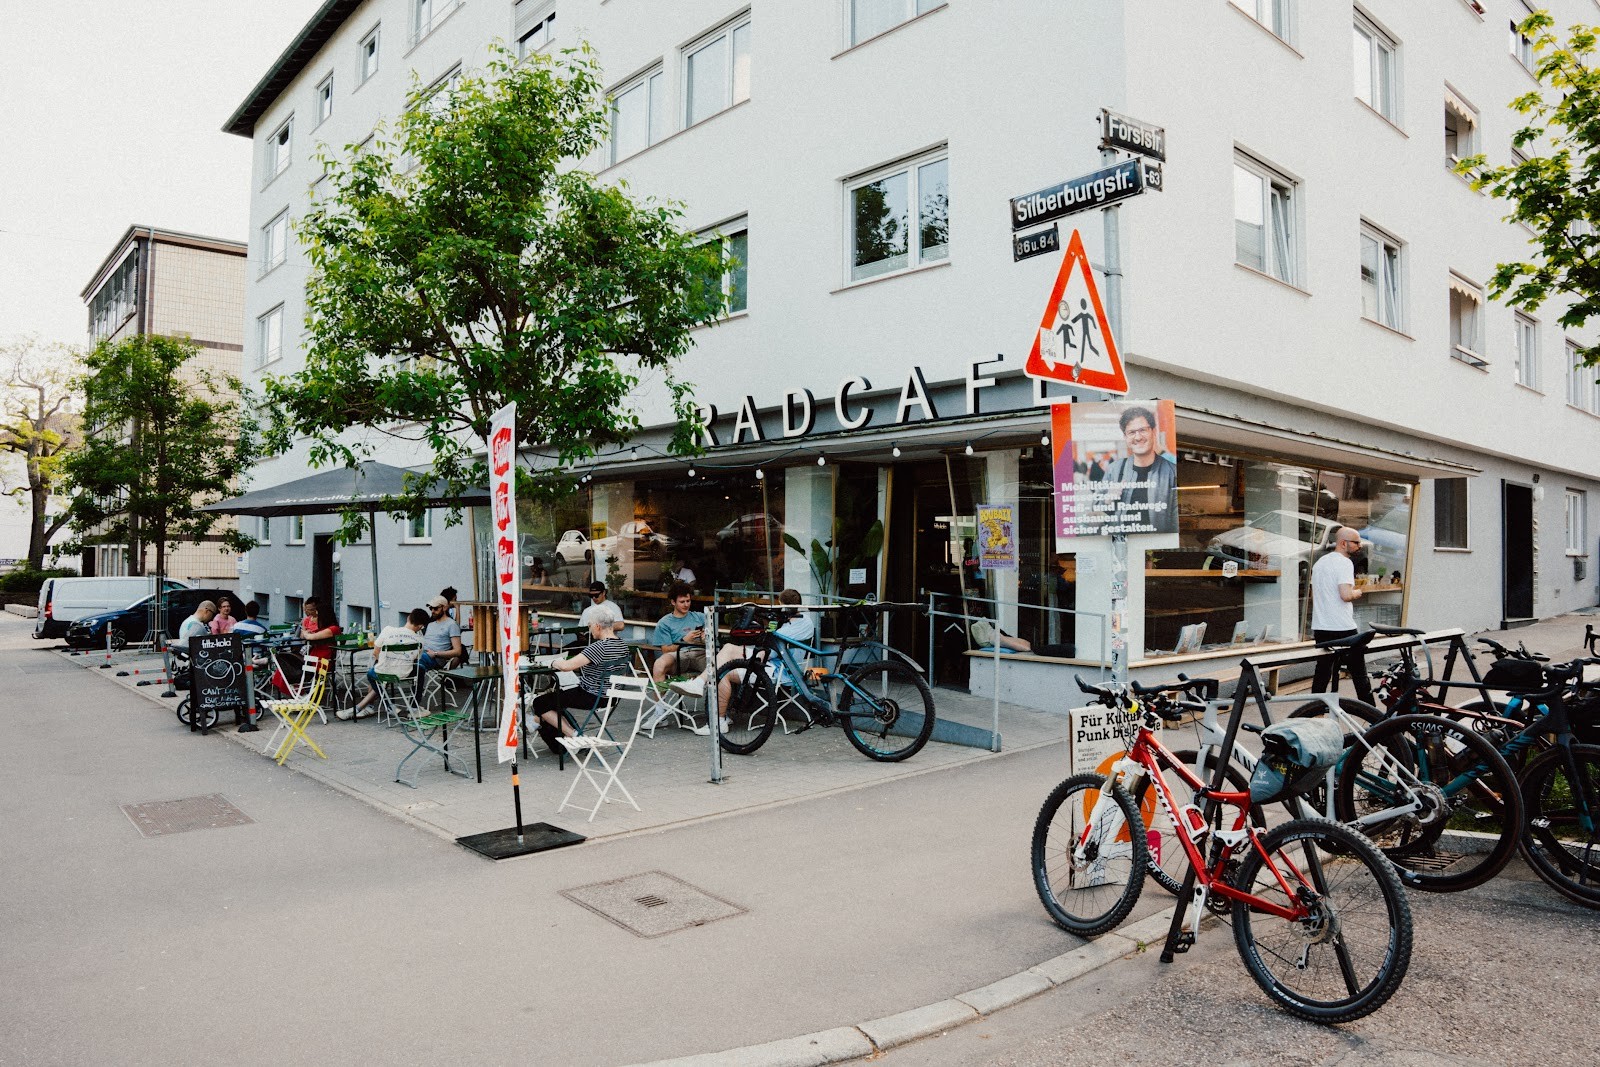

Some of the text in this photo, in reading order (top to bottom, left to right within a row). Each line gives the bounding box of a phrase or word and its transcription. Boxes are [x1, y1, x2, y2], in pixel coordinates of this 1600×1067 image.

[1108, 115, 1163, 153] Forststr.
[1017, 168, 1134, 222] Silberburgstr.
[1040, 233, 1055, 249] 84
[1093, 502, 1115, 512] und
[1117, 501, 1168, 512] Radwege
[1063, 512, 1142, 524] ausbauen und
[1063, 522, 1158, 536] sicher gestalten.
[1080, 714, 1103, 728] Für
[1410, 721, 1444, 733] SWISS
[1076, 728, 1111, 743] Punk
[1160, 873, 1183, 892] SWISS
